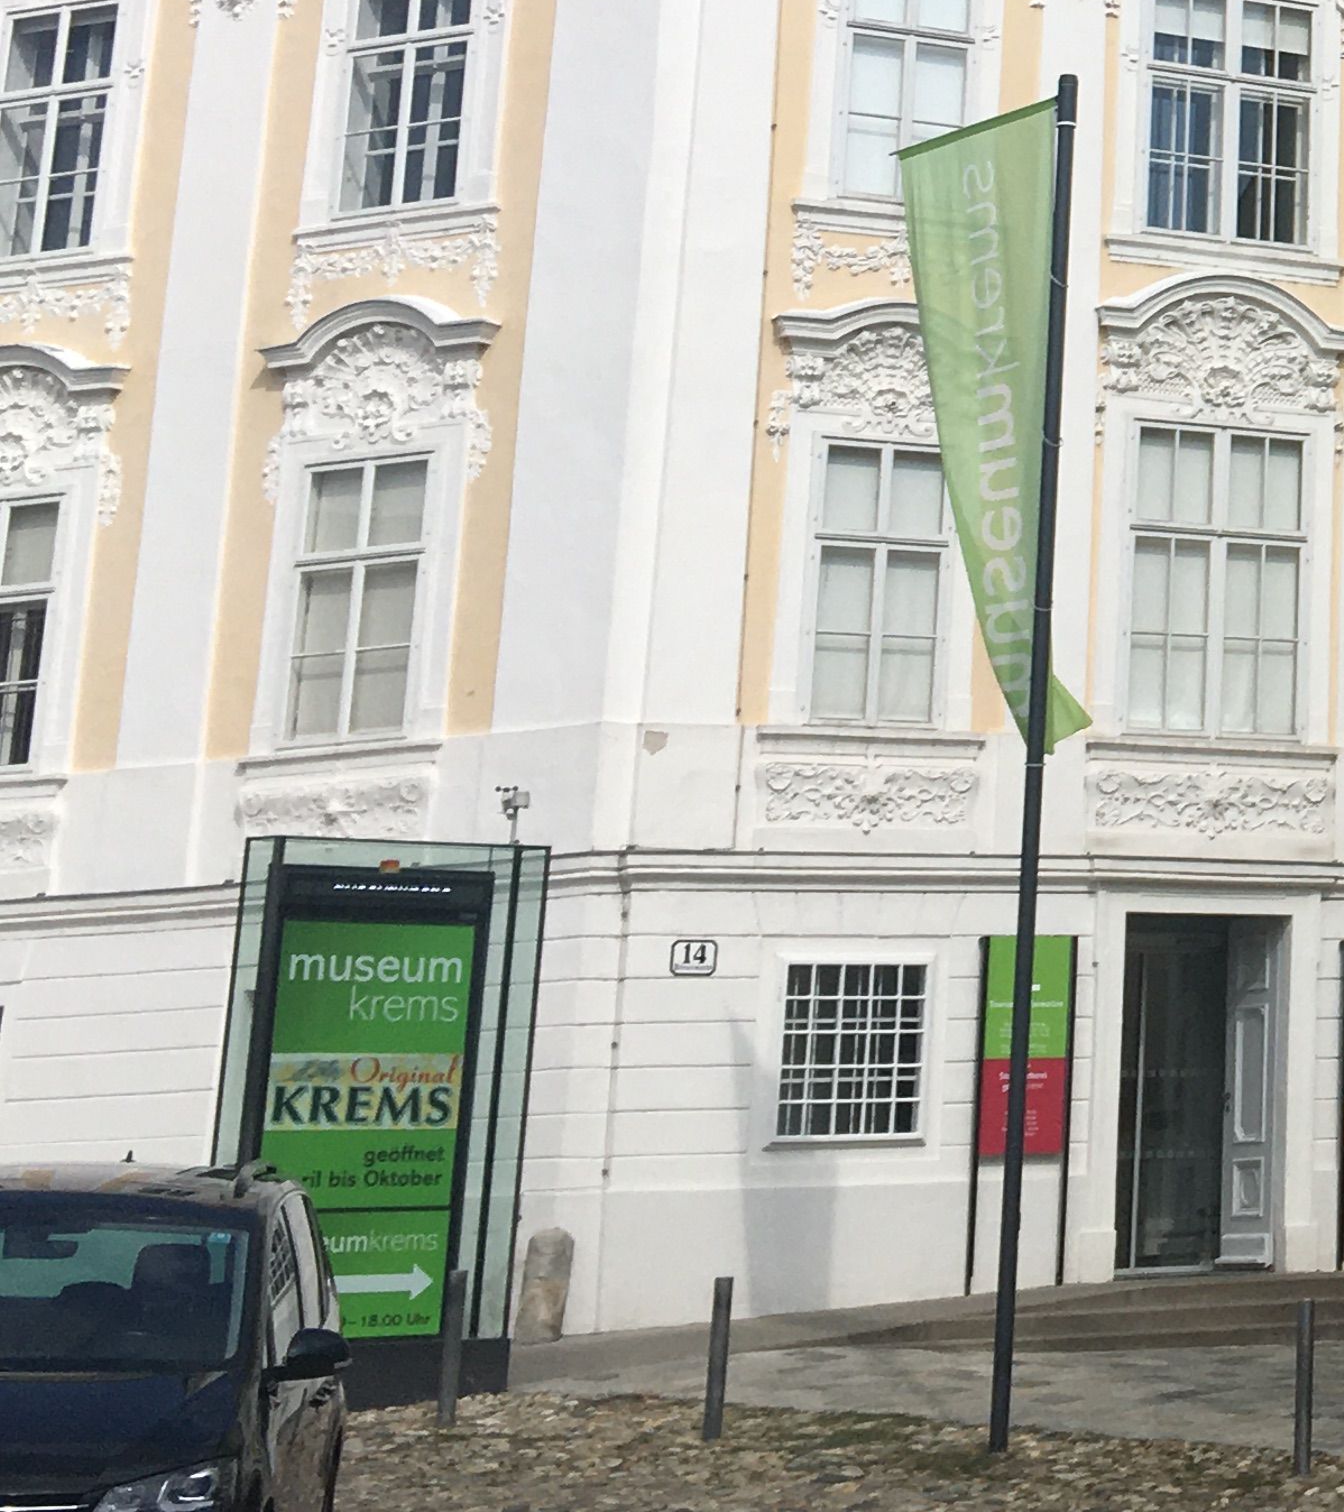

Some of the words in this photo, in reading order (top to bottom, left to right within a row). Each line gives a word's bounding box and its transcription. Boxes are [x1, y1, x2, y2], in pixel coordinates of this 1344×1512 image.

[288, 953, 463, 983] museum
[683, 942, 707, 965] 14
[350, 985, 459, 1022] krems
[351, 1054, 460, 1093] Original
[270, 1085, 453, 1127] KREMS
[363, 1144, 446, 1167] geöffnet
[302, 1169, 322, 1188] ril
[328, 1170, 357, 1188] bis
[363, 1169, 443, 1188] Oktober
